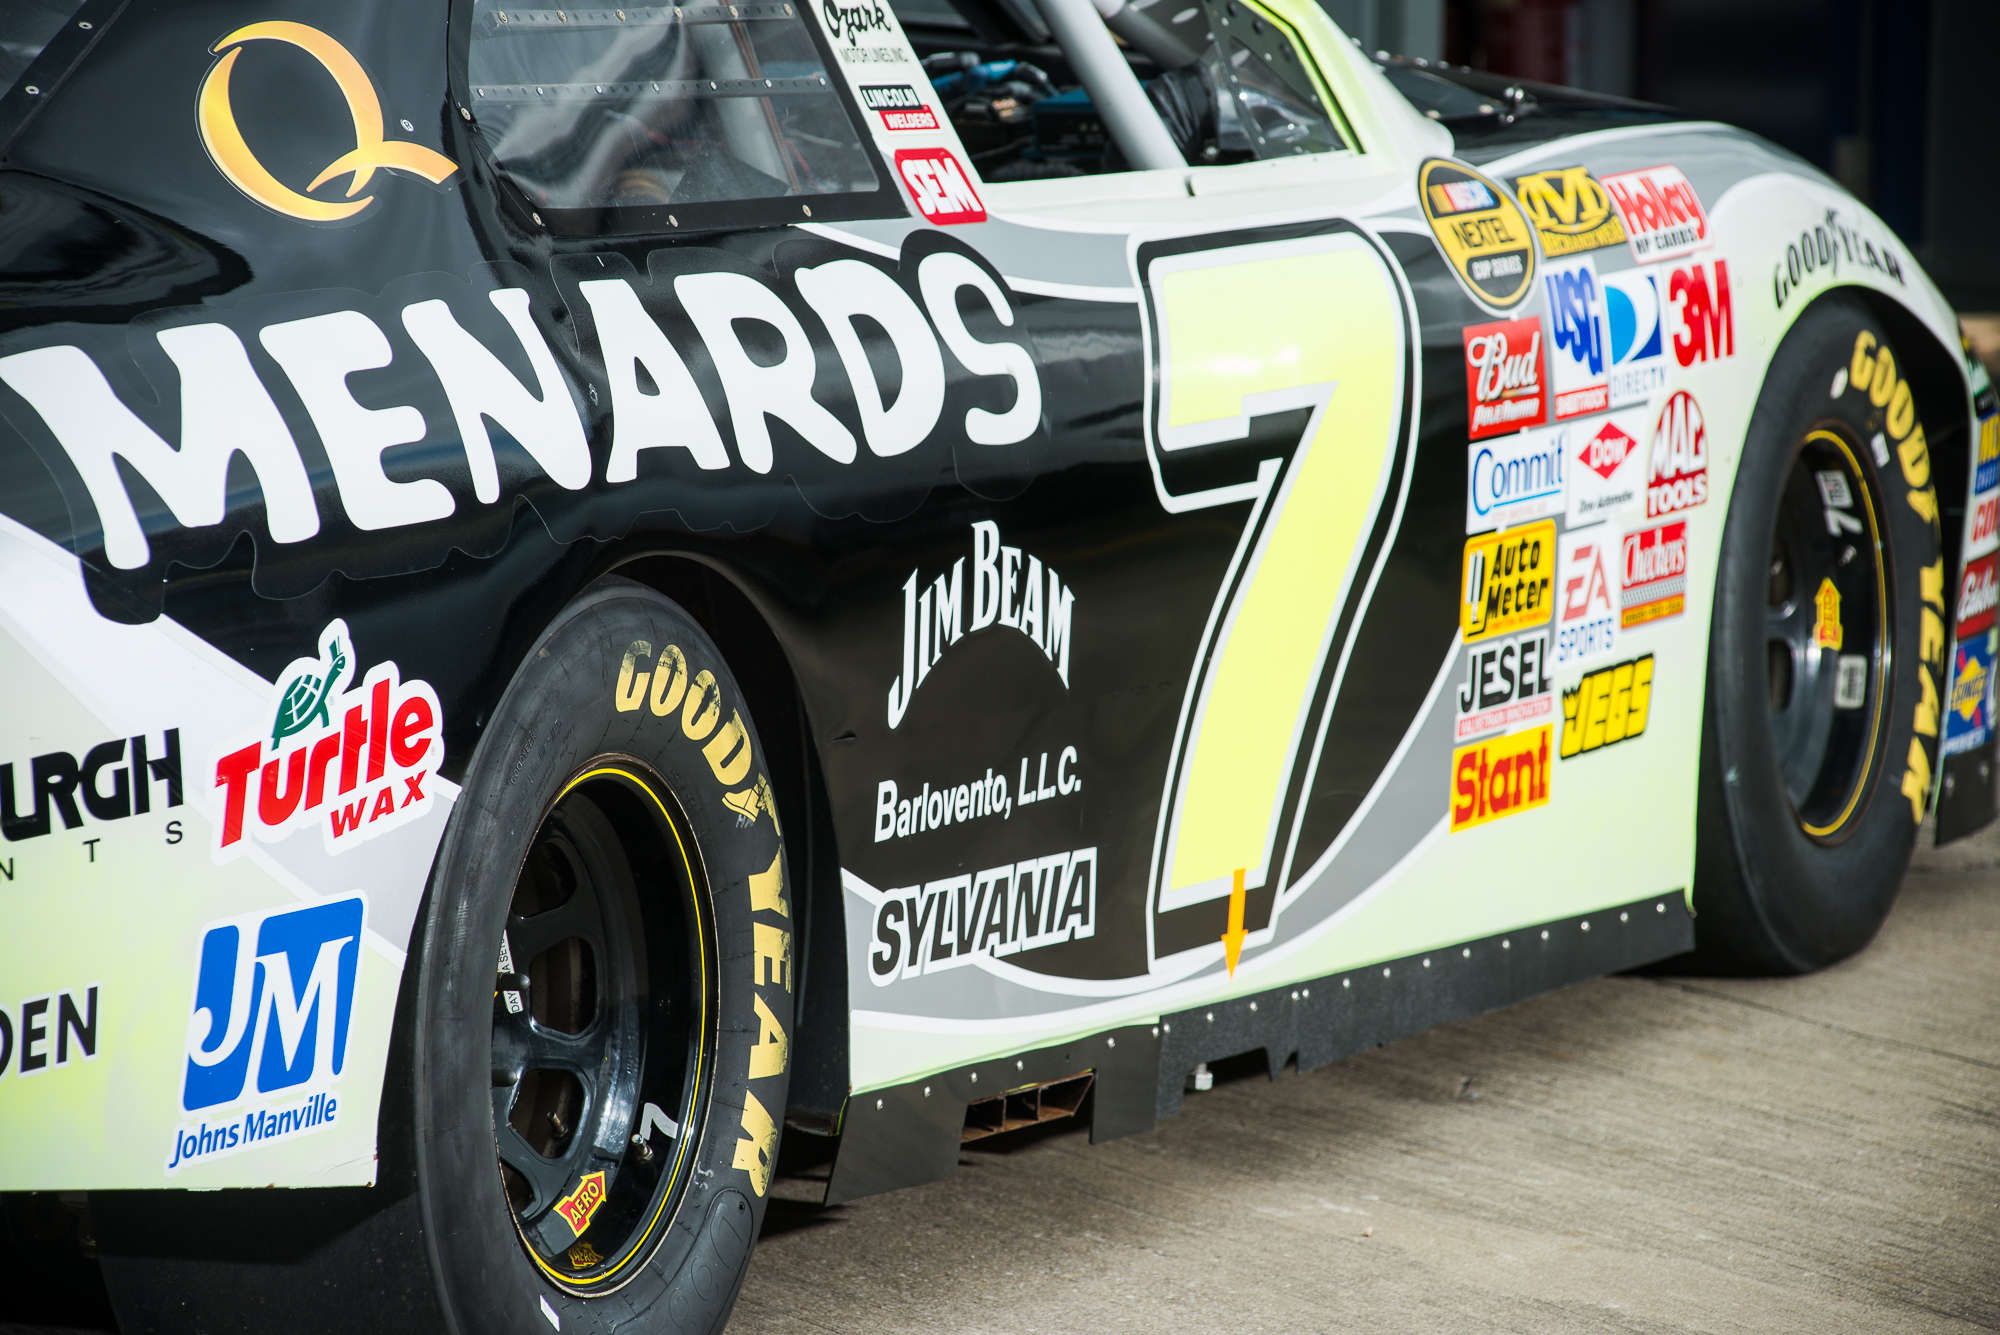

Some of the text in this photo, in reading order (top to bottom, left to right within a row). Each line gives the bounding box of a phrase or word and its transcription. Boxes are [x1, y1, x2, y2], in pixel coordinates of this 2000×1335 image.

[200, 20, 459, 222] Q
[861, 88, 920, 108] LINCOLN
[884, 112, 937, 129] WELDERS
[901, 157, 984, 216] SEM
[1607, 176, 1705, 240] Holley
[1450, 217, 1516, 251] NEXTEL
[1774, 210, 1905, 309] GOODYEAR
[1545, 267, 1604, 377] USG
[1669, 259, 1735, 368] 3M
[1467, 331, 1542, 402] Bud
[0, 249, 1043, 570] MENARDS
[1652, 393, 1707, 481] MAC
[1473, 431, 1563, 516] Commit
[1588, 436, 1629, 469] DOW
[1648, 472, 1708, 517] TOOLS
[1138, 222, 1415, 950] 7
[1485, 577, 1549, 623] Meter
[1491, 538, 1541, 581] Auto
[1563, 545, 1612, 622] EA
[1850, 329, 1945, 825] GOODYEAR
[887, 520, 1076, 730] JIM BEAM
[1558, 616, 1613, 662] SPORTS
[1460, 637, 1551, 714] JESEL
[1560, 652, 1654, 760] JEGS
[215, 678, 434, 848] Turtle
[875, 745, 1083, 843] Barlovento, L.L.C.
[1454, 730, 1547, 825] Stant
[330, 769, 426, 839] WAX
[614, 640, 794, 1197] GOODYEAR
[869, 848, 1098, 986] SYLVANIA
[186, 905, 358, 1100] JM
[168, 1092, 337, 1169] Johns Manville
[639, 1102, 679, 1141] 7
[570, 1180, 601, 1226] AERO
